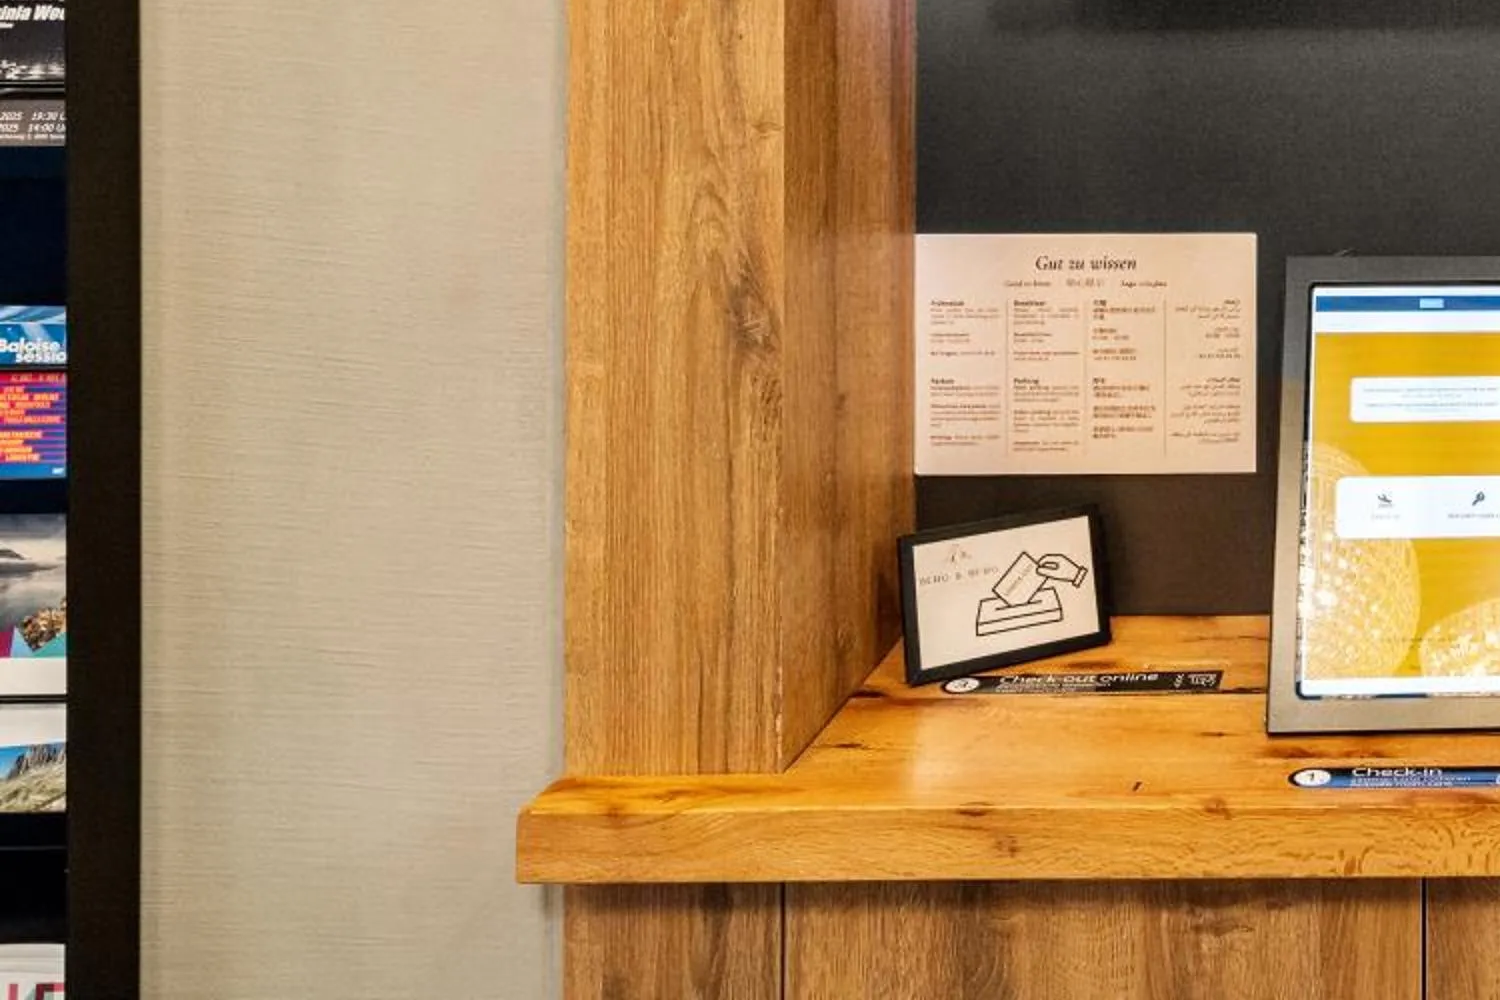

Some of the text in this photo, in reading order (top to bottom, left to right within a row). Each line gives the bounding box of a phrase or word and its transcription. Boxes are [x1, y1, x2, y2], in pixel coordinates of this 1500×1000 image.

[1035, 255, 1138, 271] Gut zu wissen
[0, 337, 61, 353] Baloise
